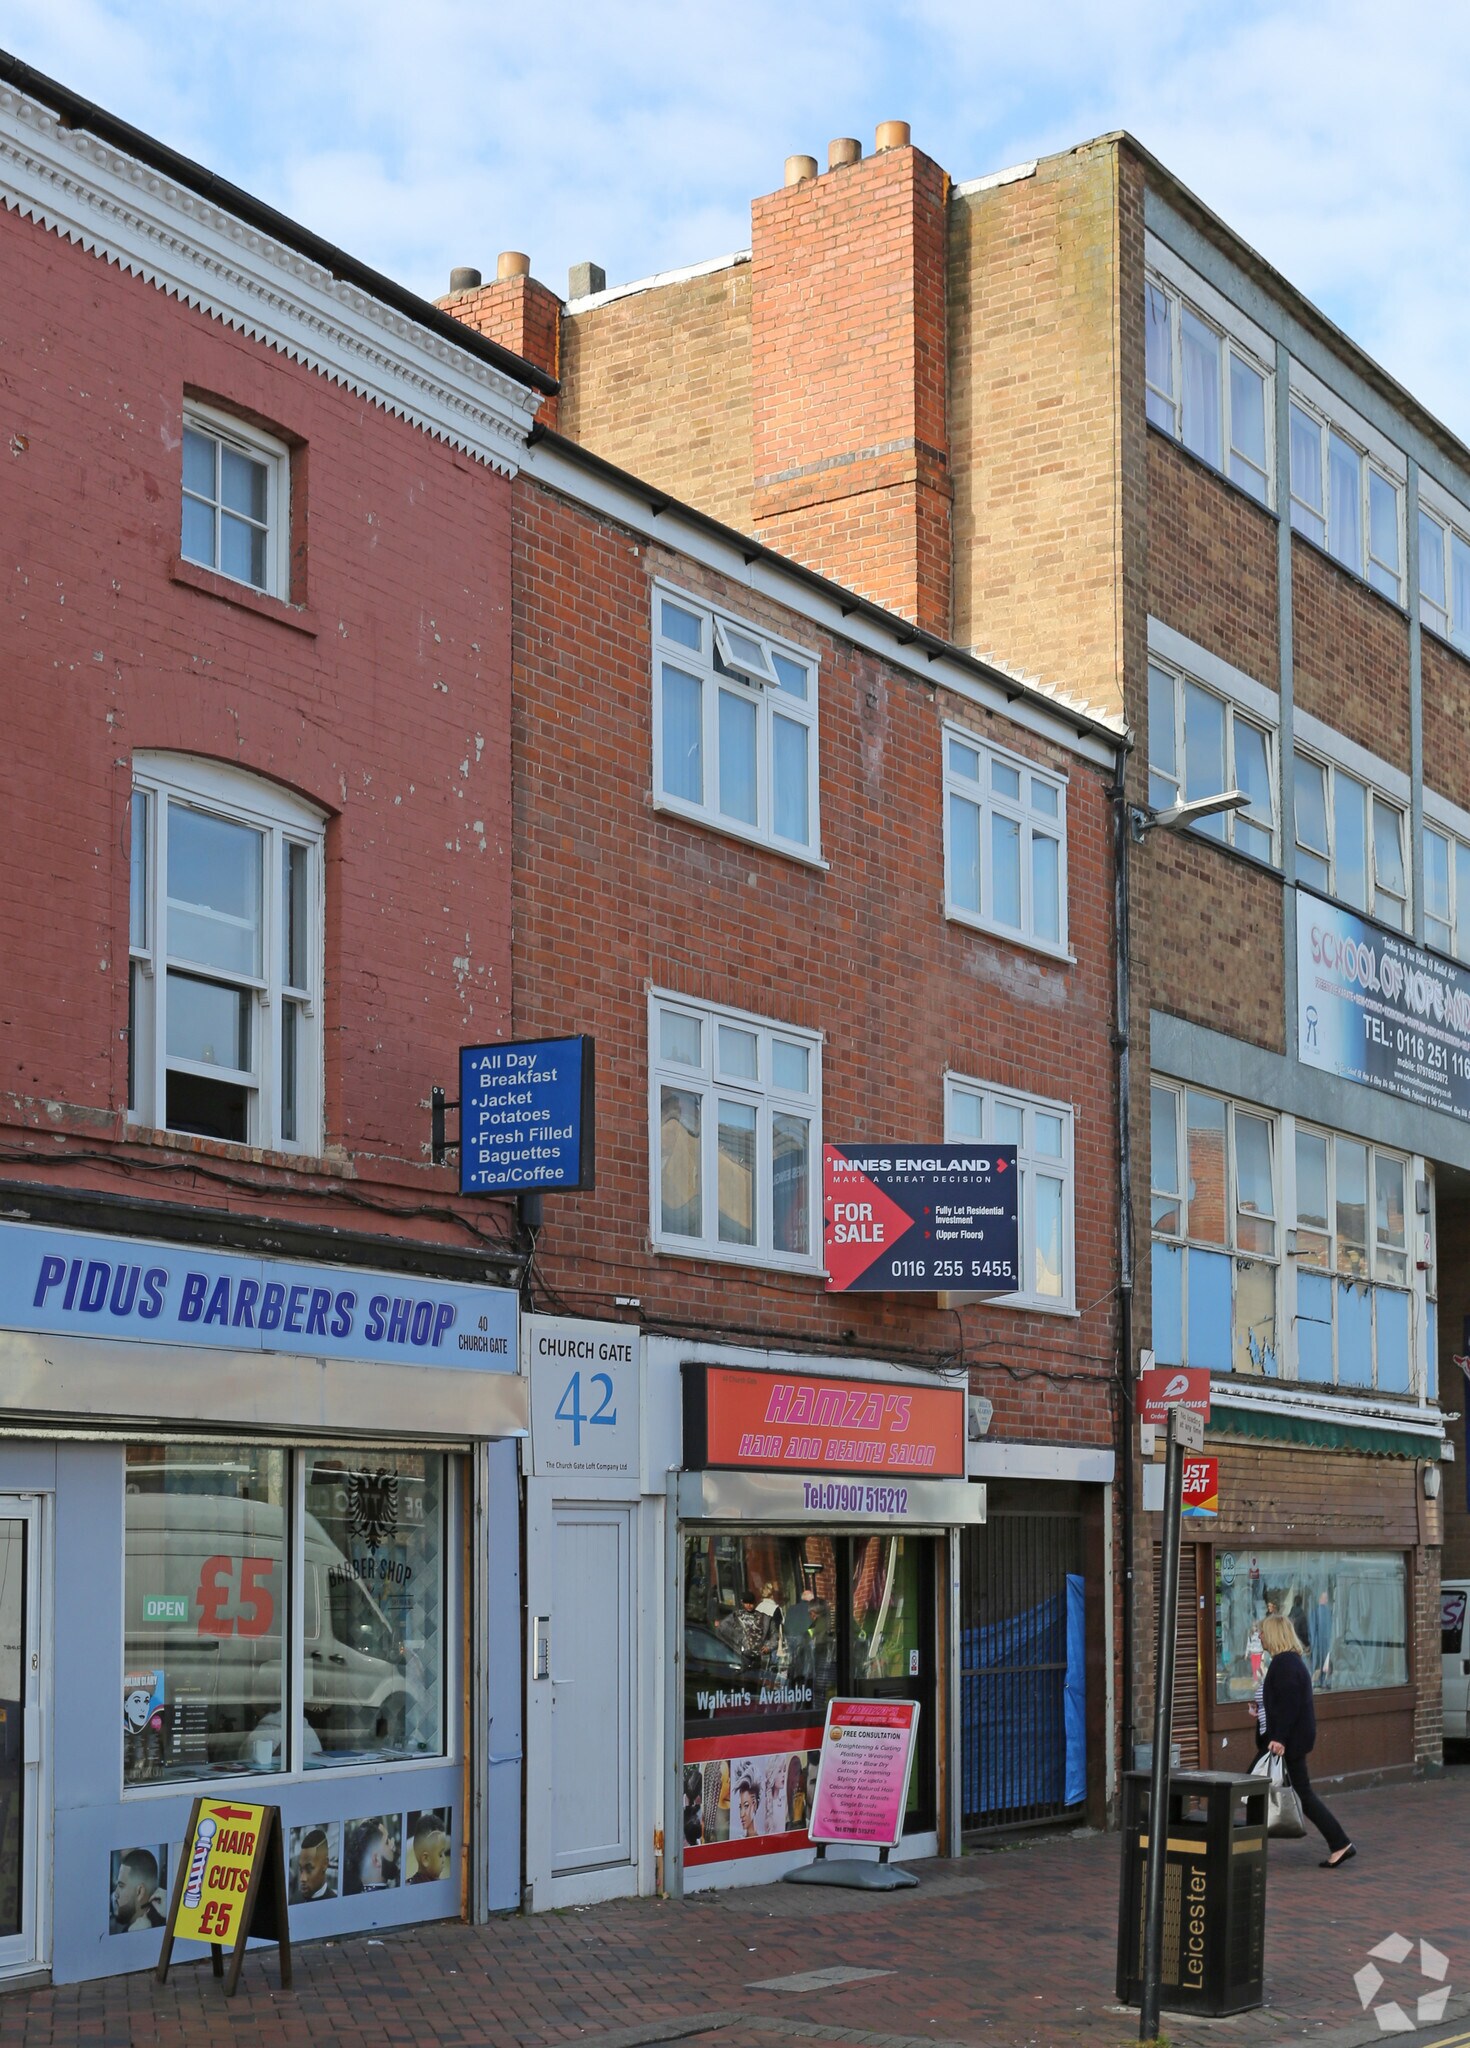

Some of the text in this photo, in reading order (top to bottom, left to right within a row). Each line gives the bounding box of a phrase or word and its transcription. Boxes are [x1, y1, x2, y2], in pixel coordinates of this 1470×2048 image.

[1311, 926, 1380, 993] SCHOOL
[1363, 1014, 1393, 1047] TEL:
[1397, 1029, 1424, 1060] 0116
[1428, 1042, 1448, 1070] 251
[480, 1054, 537, 1070] All Day
[480, 1068, 557, 1088] Breakfast
[479, 1091, 532, 1107] Jacket
[479, 1109, 550, 1125] Potatoes
[479, 1125, 572, 1145] Fresh Filled
[479, 1147, 560, 1165] Baguettes
[833, 1159, 991, 1172] INNES ENGLAND
[478, 1167, 564, 1184] Tea/Coffee
[834, 1203, 873, 1222] FOR
[936, 1206, 1004, 1216] Fully Let Residential
[936, 1216, 973, 1224] Investment
[834, 1223, 884, 1243] SALE
[936, 1230, 984, 1240] (Upper Floors)
[892, 1261, 1012, 1276] 0116 255 5455
[33, 1254, 456, 1347] PIDUS BARBERS SHOP
[478, 1316, 488, 1331] 40
[459, 1334, 508, 1354] CHURCH GATE
[539, 1338, 632, 1362] CHURCH GATE
[555, 1371, 617, 1446] 42
[763, 1384, 912, 1432] HAMZA'S
[1146, 1399, 1207, 1410] hunghouse
[1180, 1412, 1186, 1420] No
[738, 1433, 936, 1467] HAIR AND BEAUTY SALON
[556, 1462, 572, 1470] Church
[573, 1462, 584, 1470] Gate
[586, 1462, 596, 1470] Loft
[596, 1462, 618, 1471] Company
[1184, 1464, 1210, 1478] UST
[1182, 1479, 1210, 1493] EAT
[866, 1486, 907, 1514] 515212
[328, 1559, 412, 1588] BARBER SHOP
[195, 1555, 274, 1639] £5
[147, 1601, 185, 1617] OPEN
[696, 1684, 813, 1710] Walk-in's Available
[858, 1732, 900, 1740] CONSULTATION
[835, 1742, 873, 1751] Straightening
[216, 1829, 255, 1856] HAIR
[208, 1865, 251, 1893] CUTS
[198, 1900, 233, 1937] £5
[1183, 1865, 1207, 1989] Leicester
